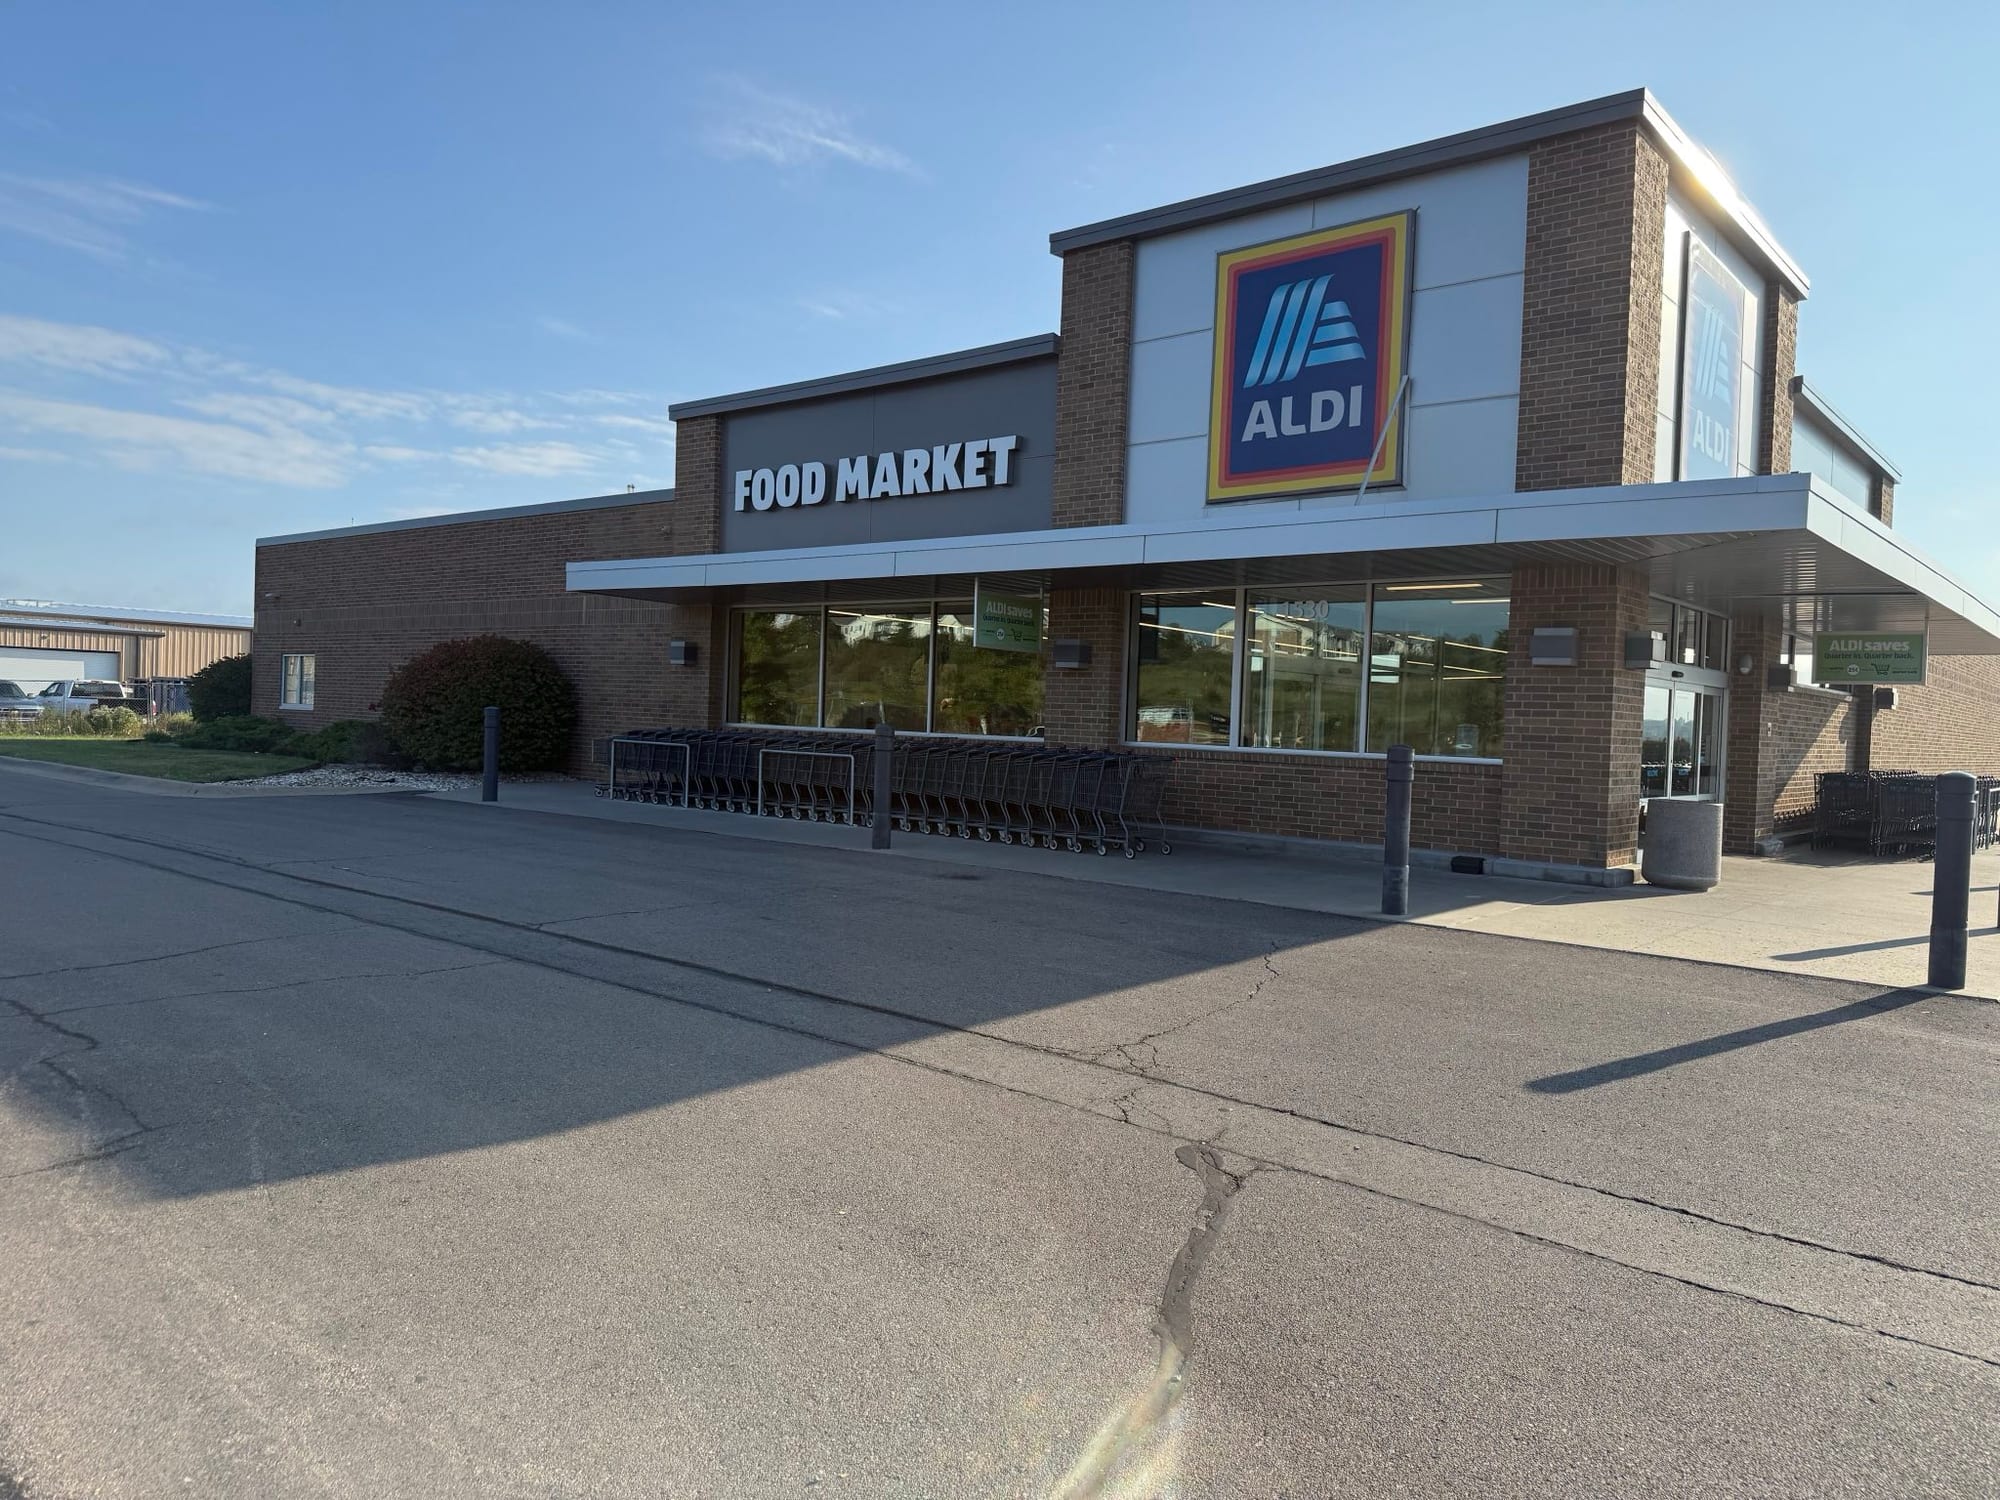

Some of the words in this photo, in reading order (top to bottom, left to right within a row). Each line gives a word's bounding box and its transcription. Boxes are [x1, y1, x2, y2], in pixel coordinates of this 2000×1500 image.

[1241, 385, 1363, 442] ALDI
[1693, 410, 1729, 467] ALDI
[734, 461, 826, 512] FOOD
[835, 435, 1017, 502] MARKET
[986, 601, 1007, 615] ALDI
[1007, 606, 1033, 618] saves
[1829, 640, 1862, 651] ALDI
[1864, 641, 1910, 651] saves
